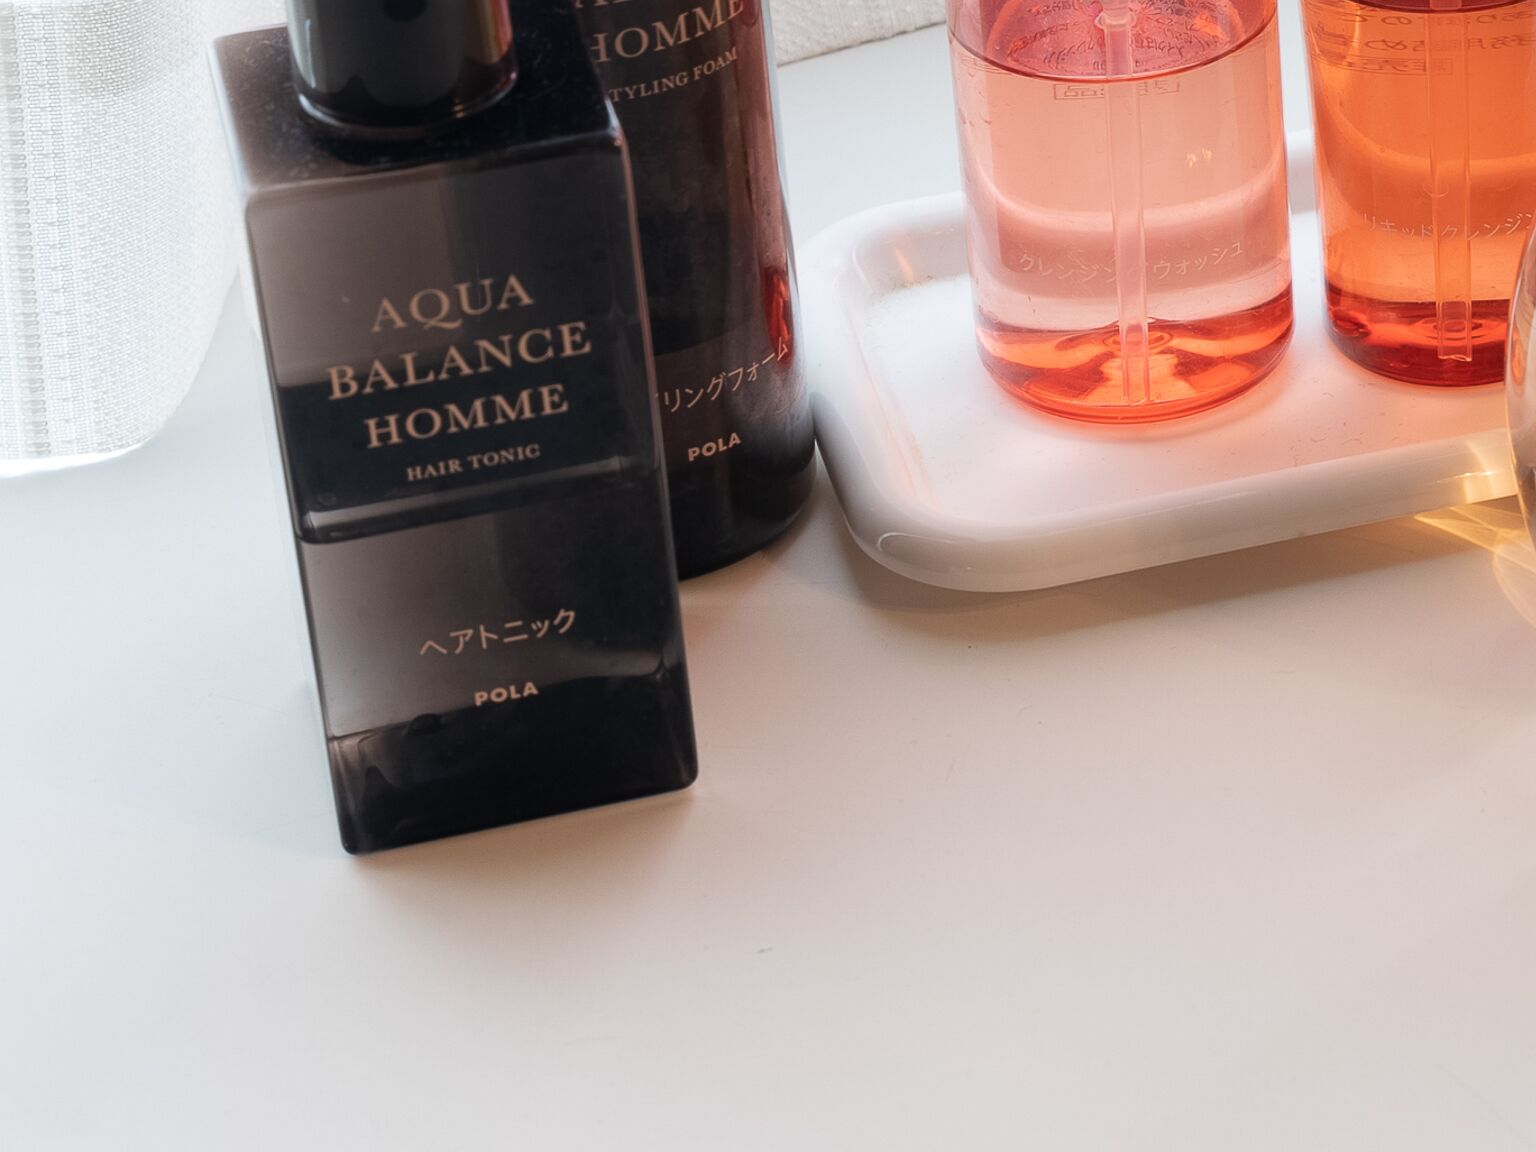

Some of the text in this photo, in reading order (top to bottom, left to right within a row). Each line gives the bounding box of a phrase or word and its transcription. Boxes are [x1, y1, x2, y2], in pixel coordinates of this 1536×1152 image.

[607, 47, 738, 103] TYLING FOAM
[1019, 242, 1243, 282] クレンジンウォッシュ
[371, 274, 534, 333] AQUA
[326, 321, 592, 400] BALANCE
[655, 336, 789, 413] リングフォーム
[364, 383, 569, 449] HOMME
[406, 444, 541, 481] HAIR TONIC
[687, 432, 742, 462] POLA
[420, 608, 576, 655] ヘアトニック
[474, 681, 539, 706] POLA
